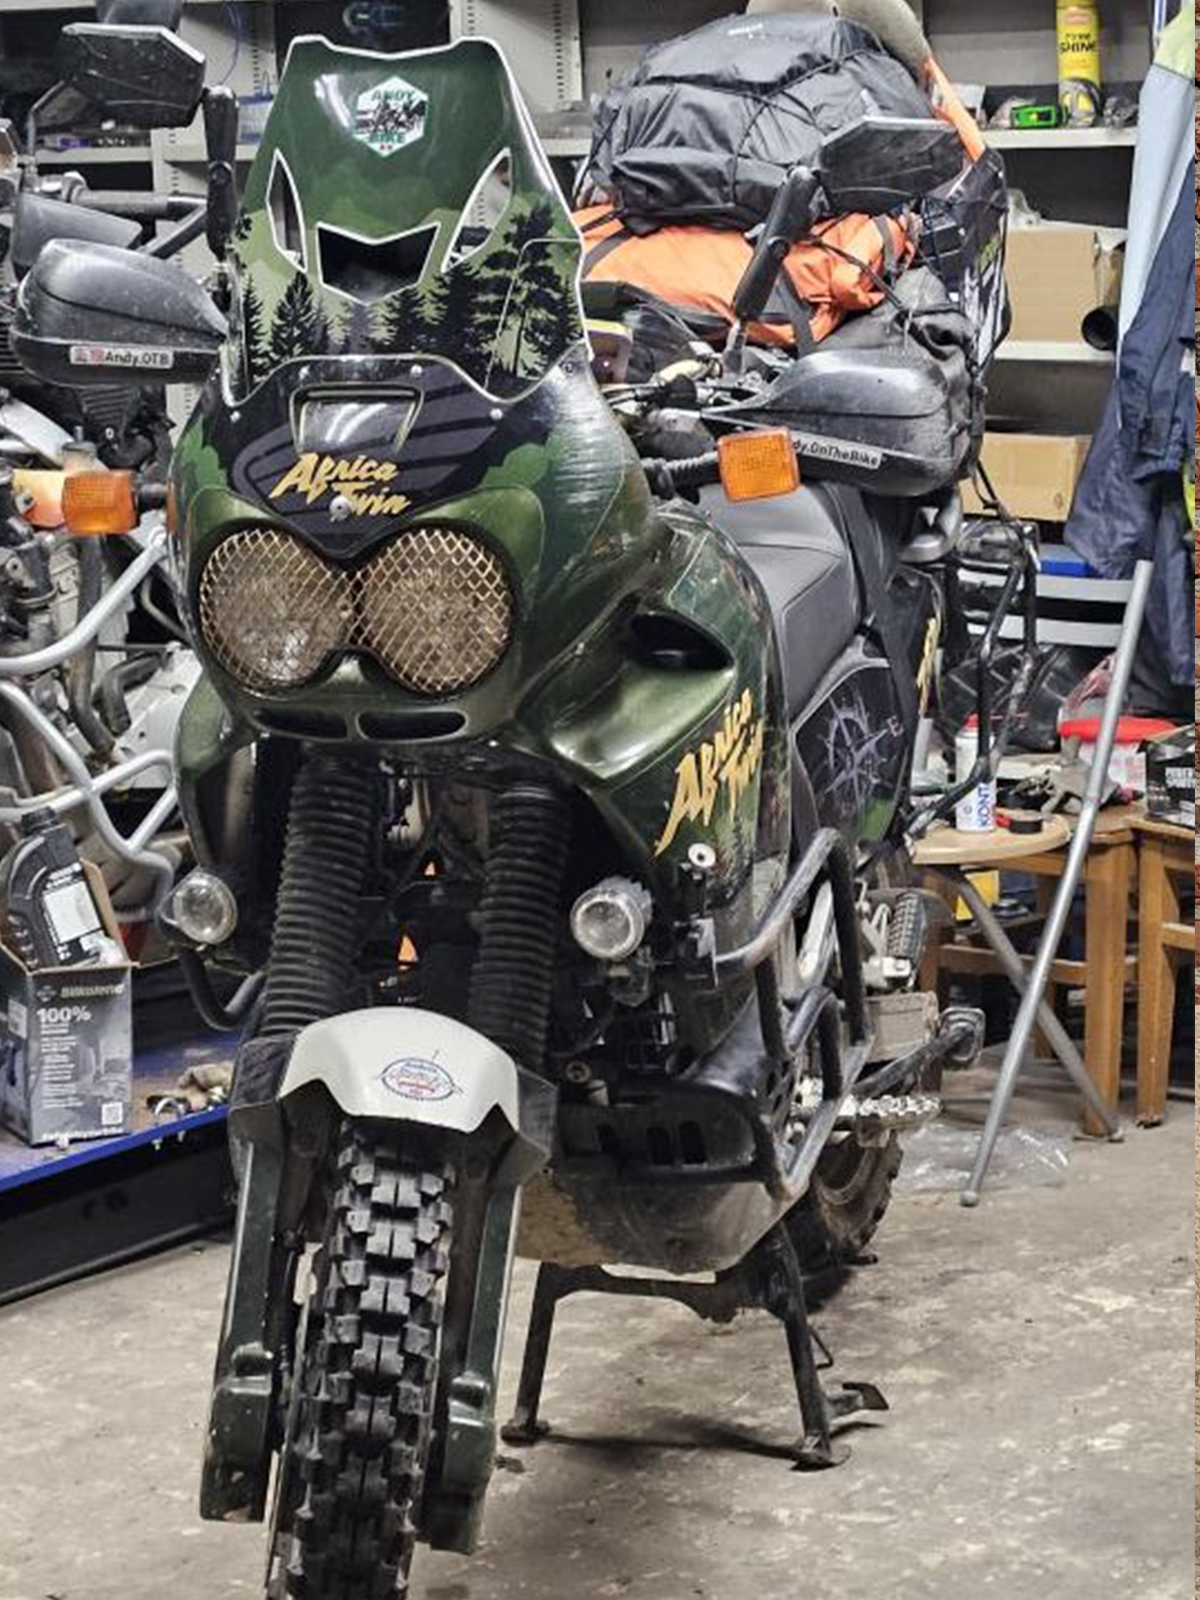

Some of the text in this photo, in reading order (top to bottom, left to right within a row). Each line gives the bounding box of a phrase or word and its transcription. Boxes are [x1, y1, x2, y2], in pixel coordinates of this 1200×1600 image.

[1060, 41, 1096, 52] SHINE
[106, 351, 169, 367] Andy.OTB
[793, 440, 878, 466] dy.OnTheBike
[269, 452, 399, 505] Africa
[331, 481, 411, 516] Twin
[654, 687, 751, 857] Africa
[37, 1005, 91, 1022] 100%
